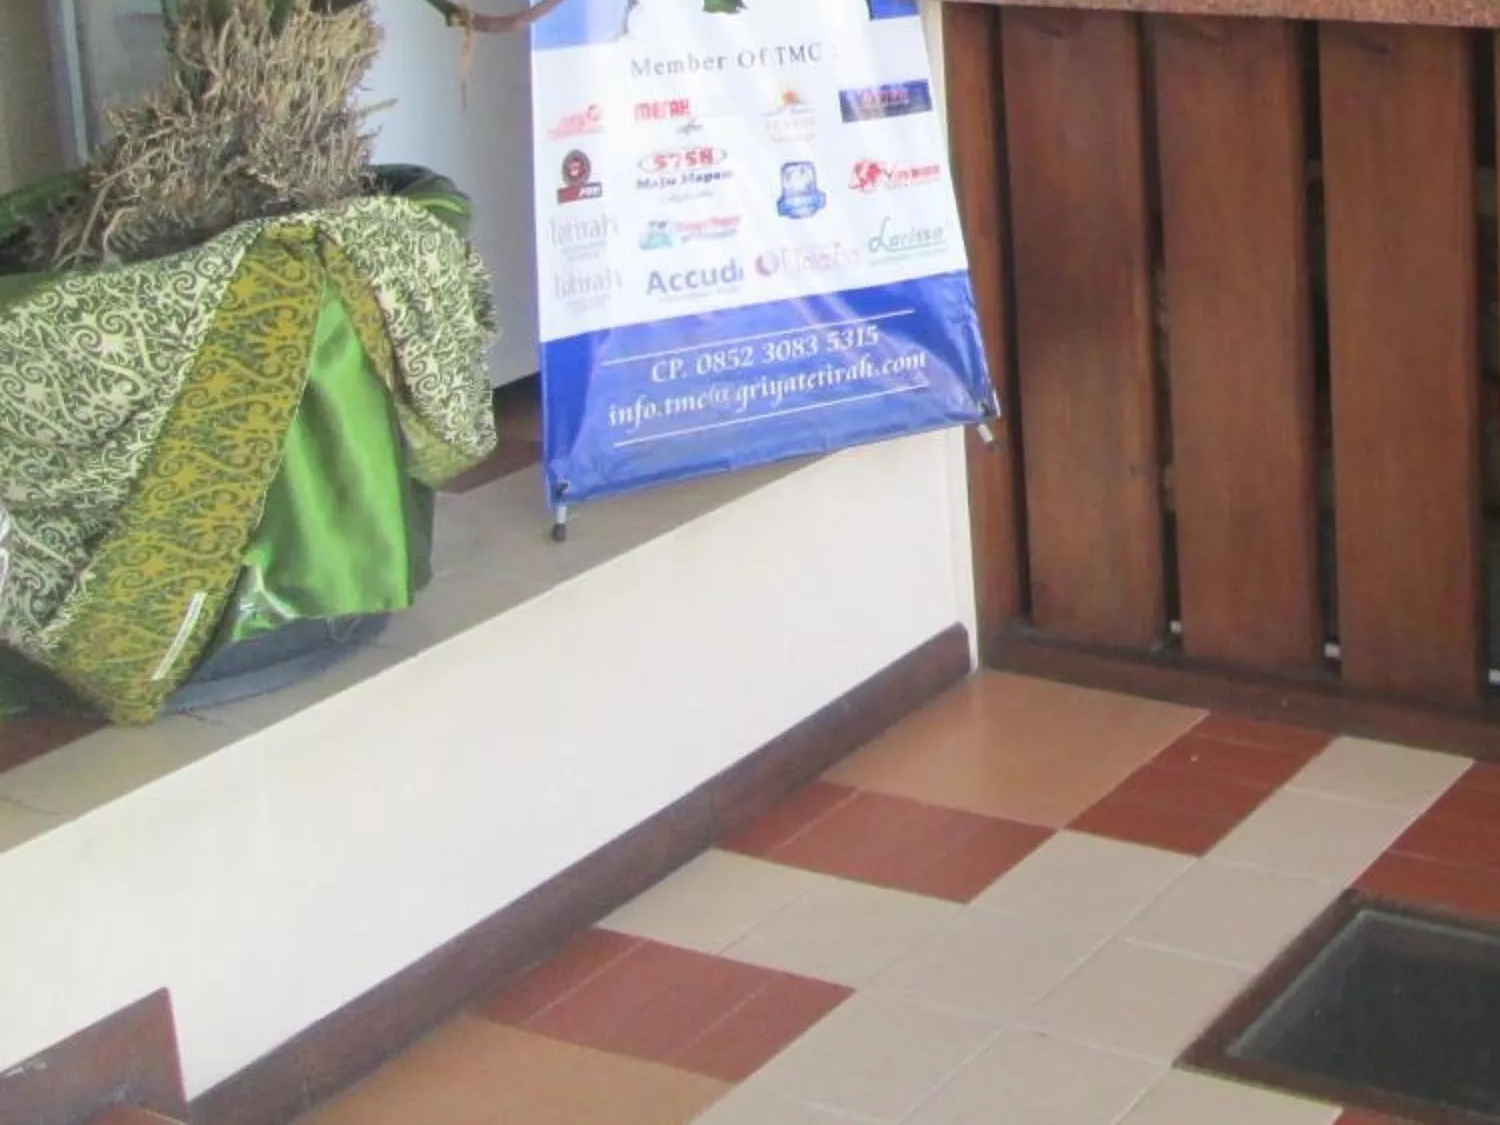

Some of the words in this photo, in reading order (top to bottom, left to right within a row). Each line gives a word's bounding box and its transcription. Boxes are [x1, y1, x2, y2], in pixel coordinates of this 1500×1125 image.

[630, 52, 726, 77] Member
[737, 45, 768, 69] Of
[777, 41, 822, 66] TMC
[696, 345, 755, 375] 0852
[761, 334, 819, 365] 3083
[827, 324, 879, 351] 5315
